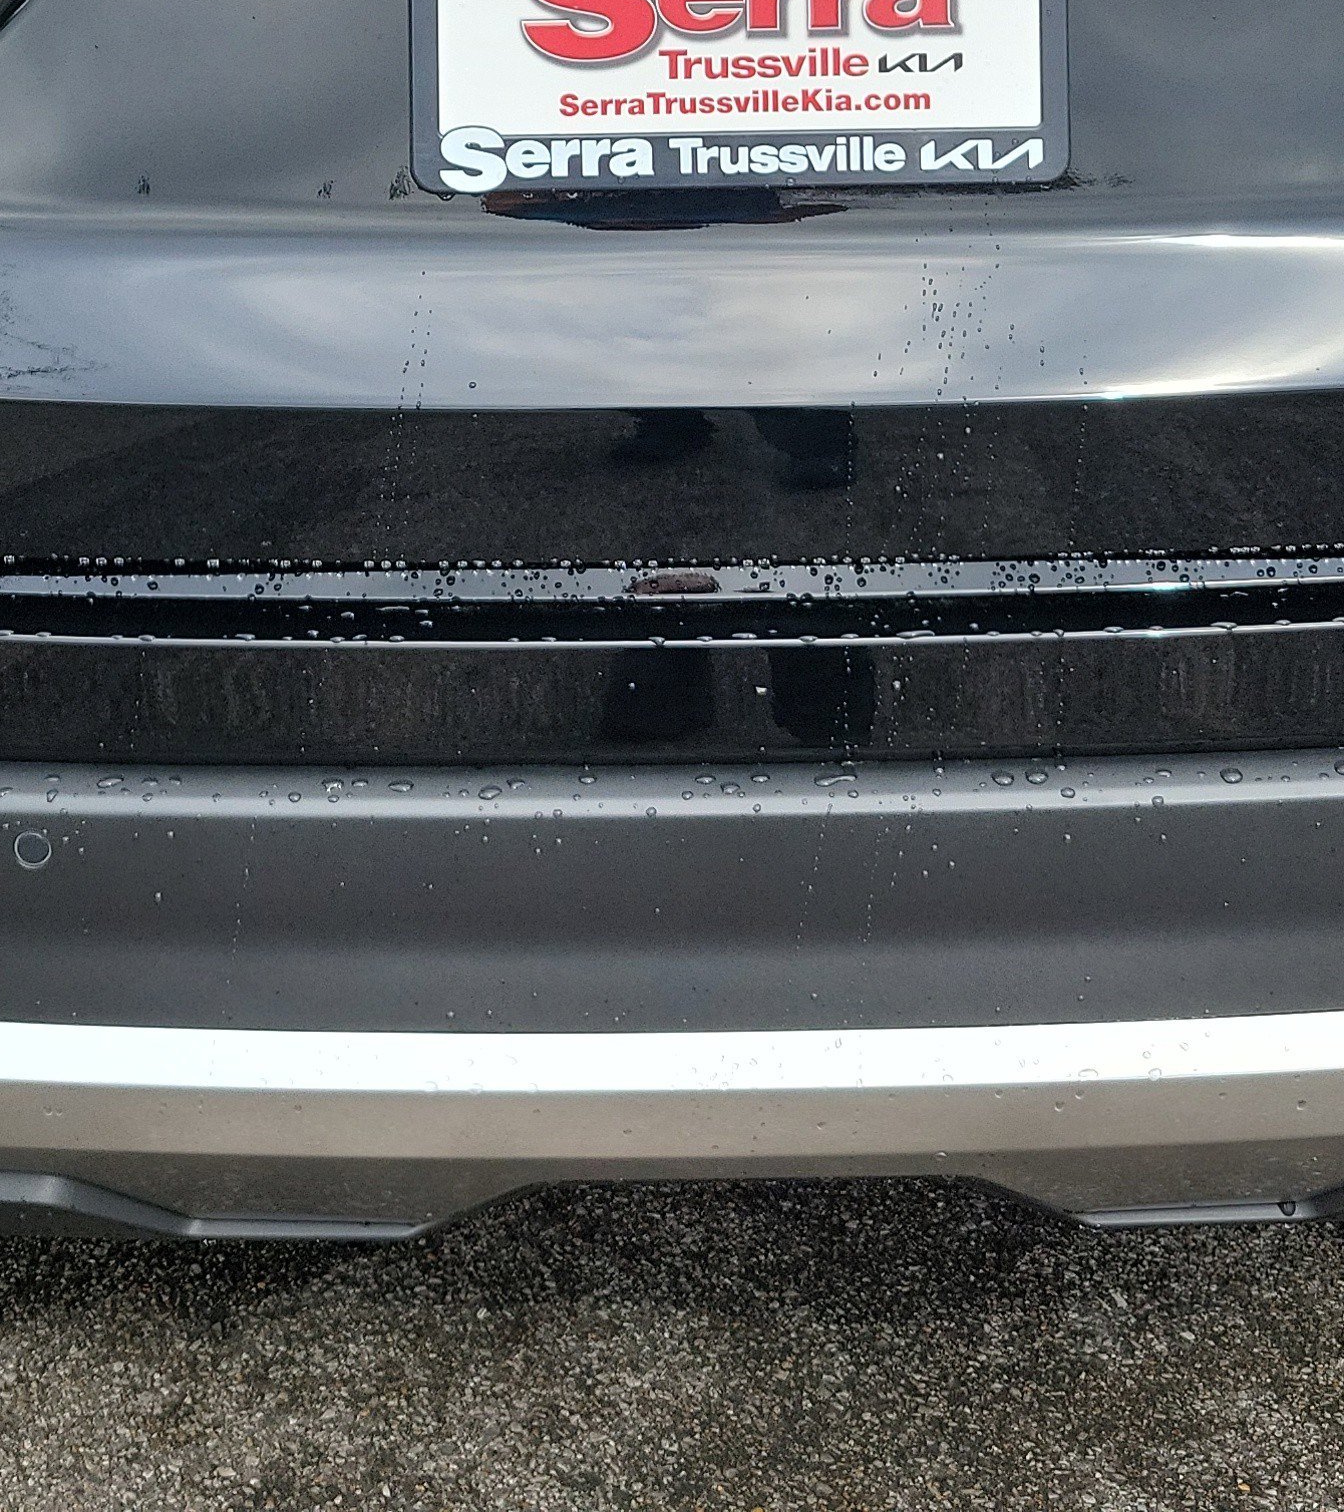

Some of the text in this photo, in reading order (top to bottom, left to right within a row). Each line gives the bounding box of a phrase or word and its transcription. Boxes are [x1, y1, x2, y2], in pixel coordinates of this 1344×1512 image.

[659, 47, 963, 81] Trussville KIA
[558, 89, 932, 118] SerraTrussvilleKia.com
[439, 126, 1045, 194] Serra Trussville KIA
